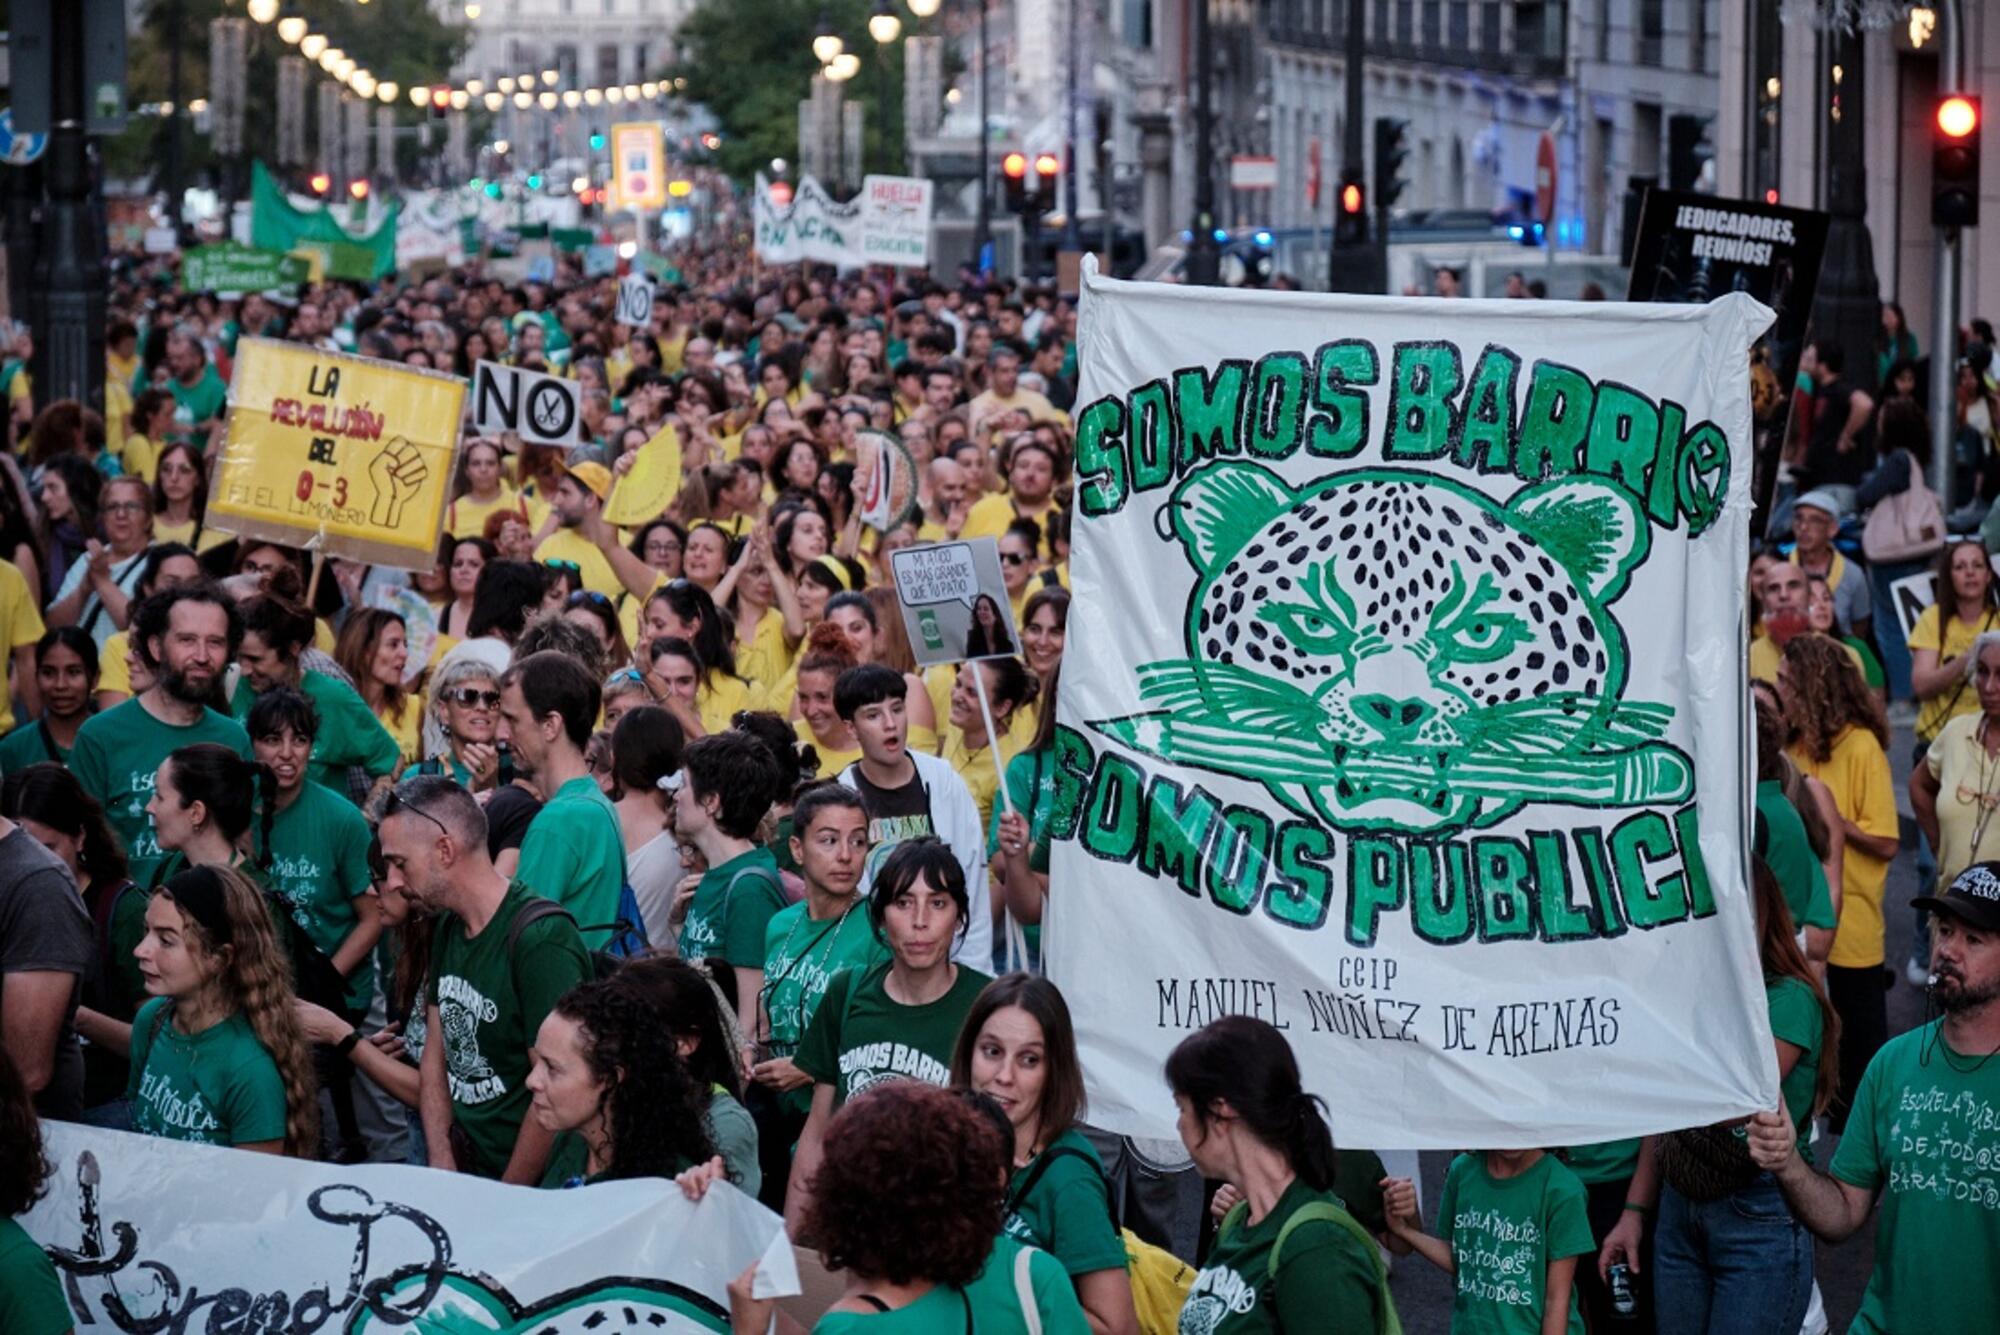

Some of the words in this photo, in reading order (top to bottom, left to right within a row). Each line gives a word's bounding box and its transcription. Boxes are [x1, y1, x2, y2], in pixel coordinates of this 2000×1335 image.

[871, 181, 923, 205] HUELGA
[1675, 204, 1797, 247] ¡EDUCADORES,
[1690, 234, 1774, 267] REUNÍOS!
[619, 282, 650, 321] NO
[306, 364, 341, 398] LA
[270, 397, 386, 442] REVOLUCIÓN
[477, 365, 576, 440] NO
[307, 437, 338, 466] DEL
[1075, 337, 1380, 517] SOMOS
[1380, 339, 1731, 539] BARRIO
[296, 470, 349, 508] 0-3
[288, 494, 366, 526] LIMONERO
[901, 570, 914, 585] ES
[934, 561, 970, 580] GRANDE
[910, 584, 928, 600] QUE
[940, 578, 969, 597] PATIO
[1050, 722, 1333, 934] SOMOS
[1156, 978, 1290, 1030] MANUEL
[1302, 989, 1421, 1042] NÚÑEZ
[1441, 1004, 1477, 1050] DE
[1487, 996, 1621, 1058] ARENAS
[838, 1041, 892, 1075] SOMOS
[890, 1043, 951, 1089] BARRI
[1900, 1088, 1961, 1118] ESCUELA
[1901, 1136, 1928, 1155] DE
[1890, 1170, 1937, 1193] PARA
[1944, 1176, 2000, 1210] TOD@
